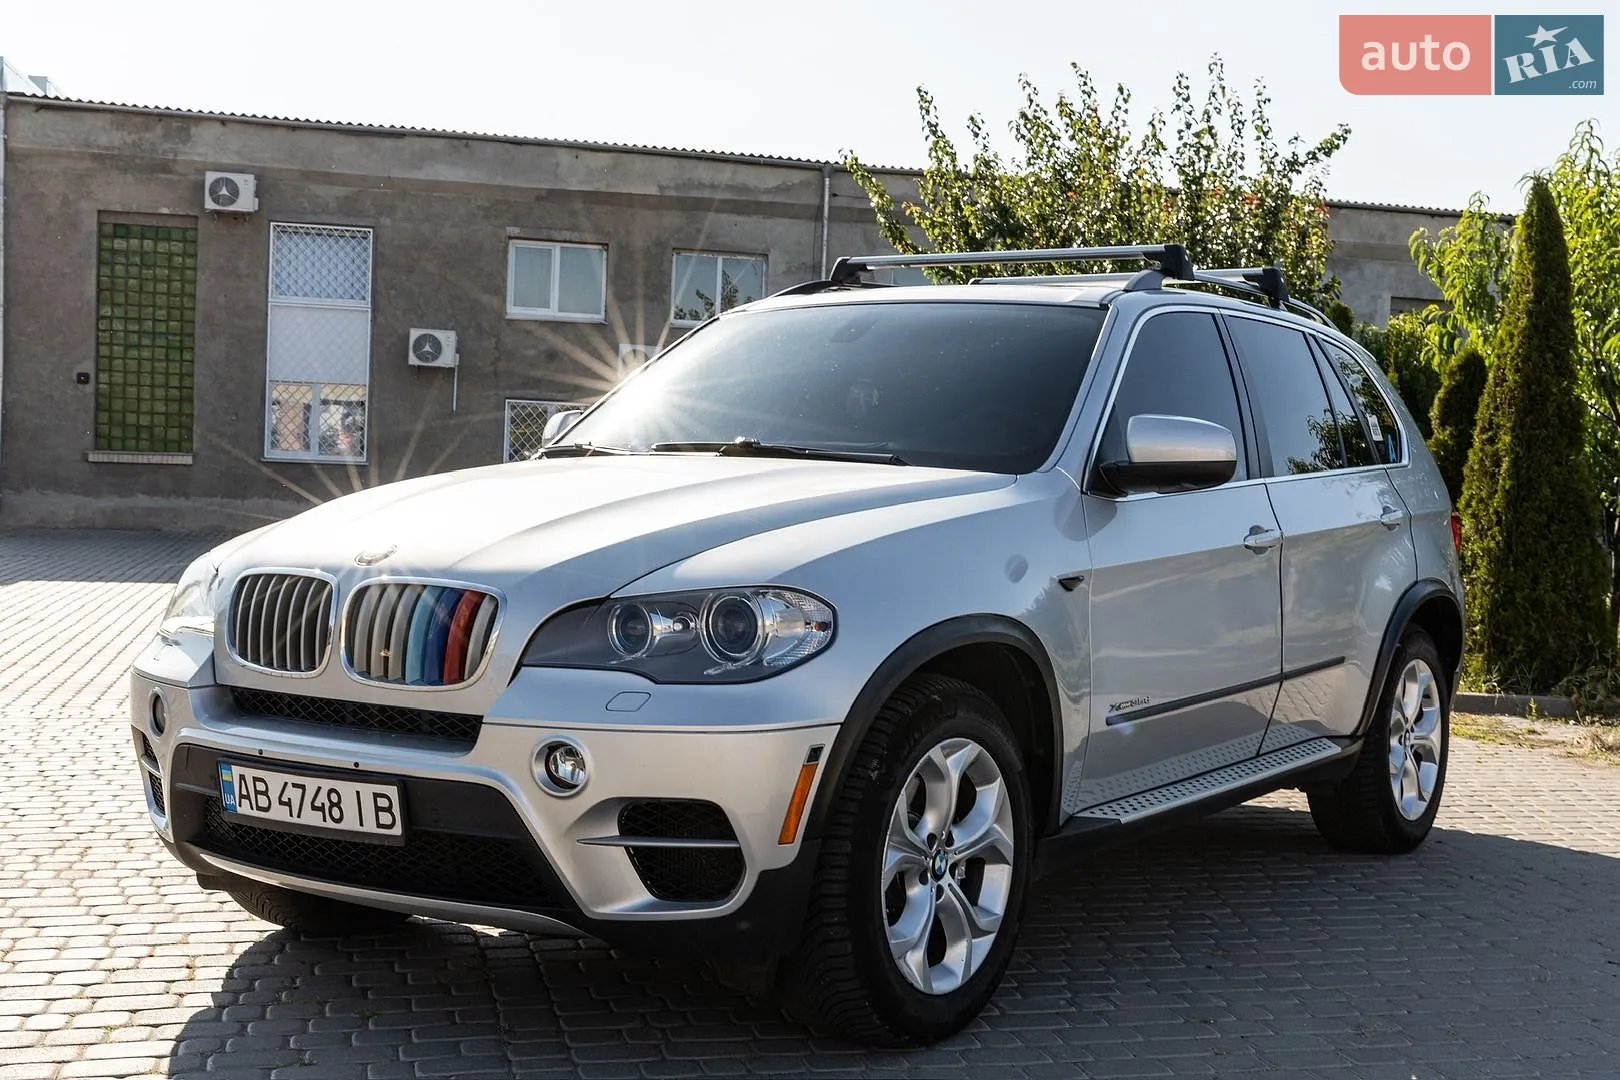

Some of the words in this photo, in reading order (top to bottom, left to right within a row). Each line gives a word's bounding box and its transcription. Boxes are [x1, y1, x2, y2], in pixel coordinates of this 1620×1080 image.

[224, 793, 236, 806] UA
[238, 773, 272, 813] AB
[278, 781, 344, 824] 4748
[355, 790, 397, 830] IB
